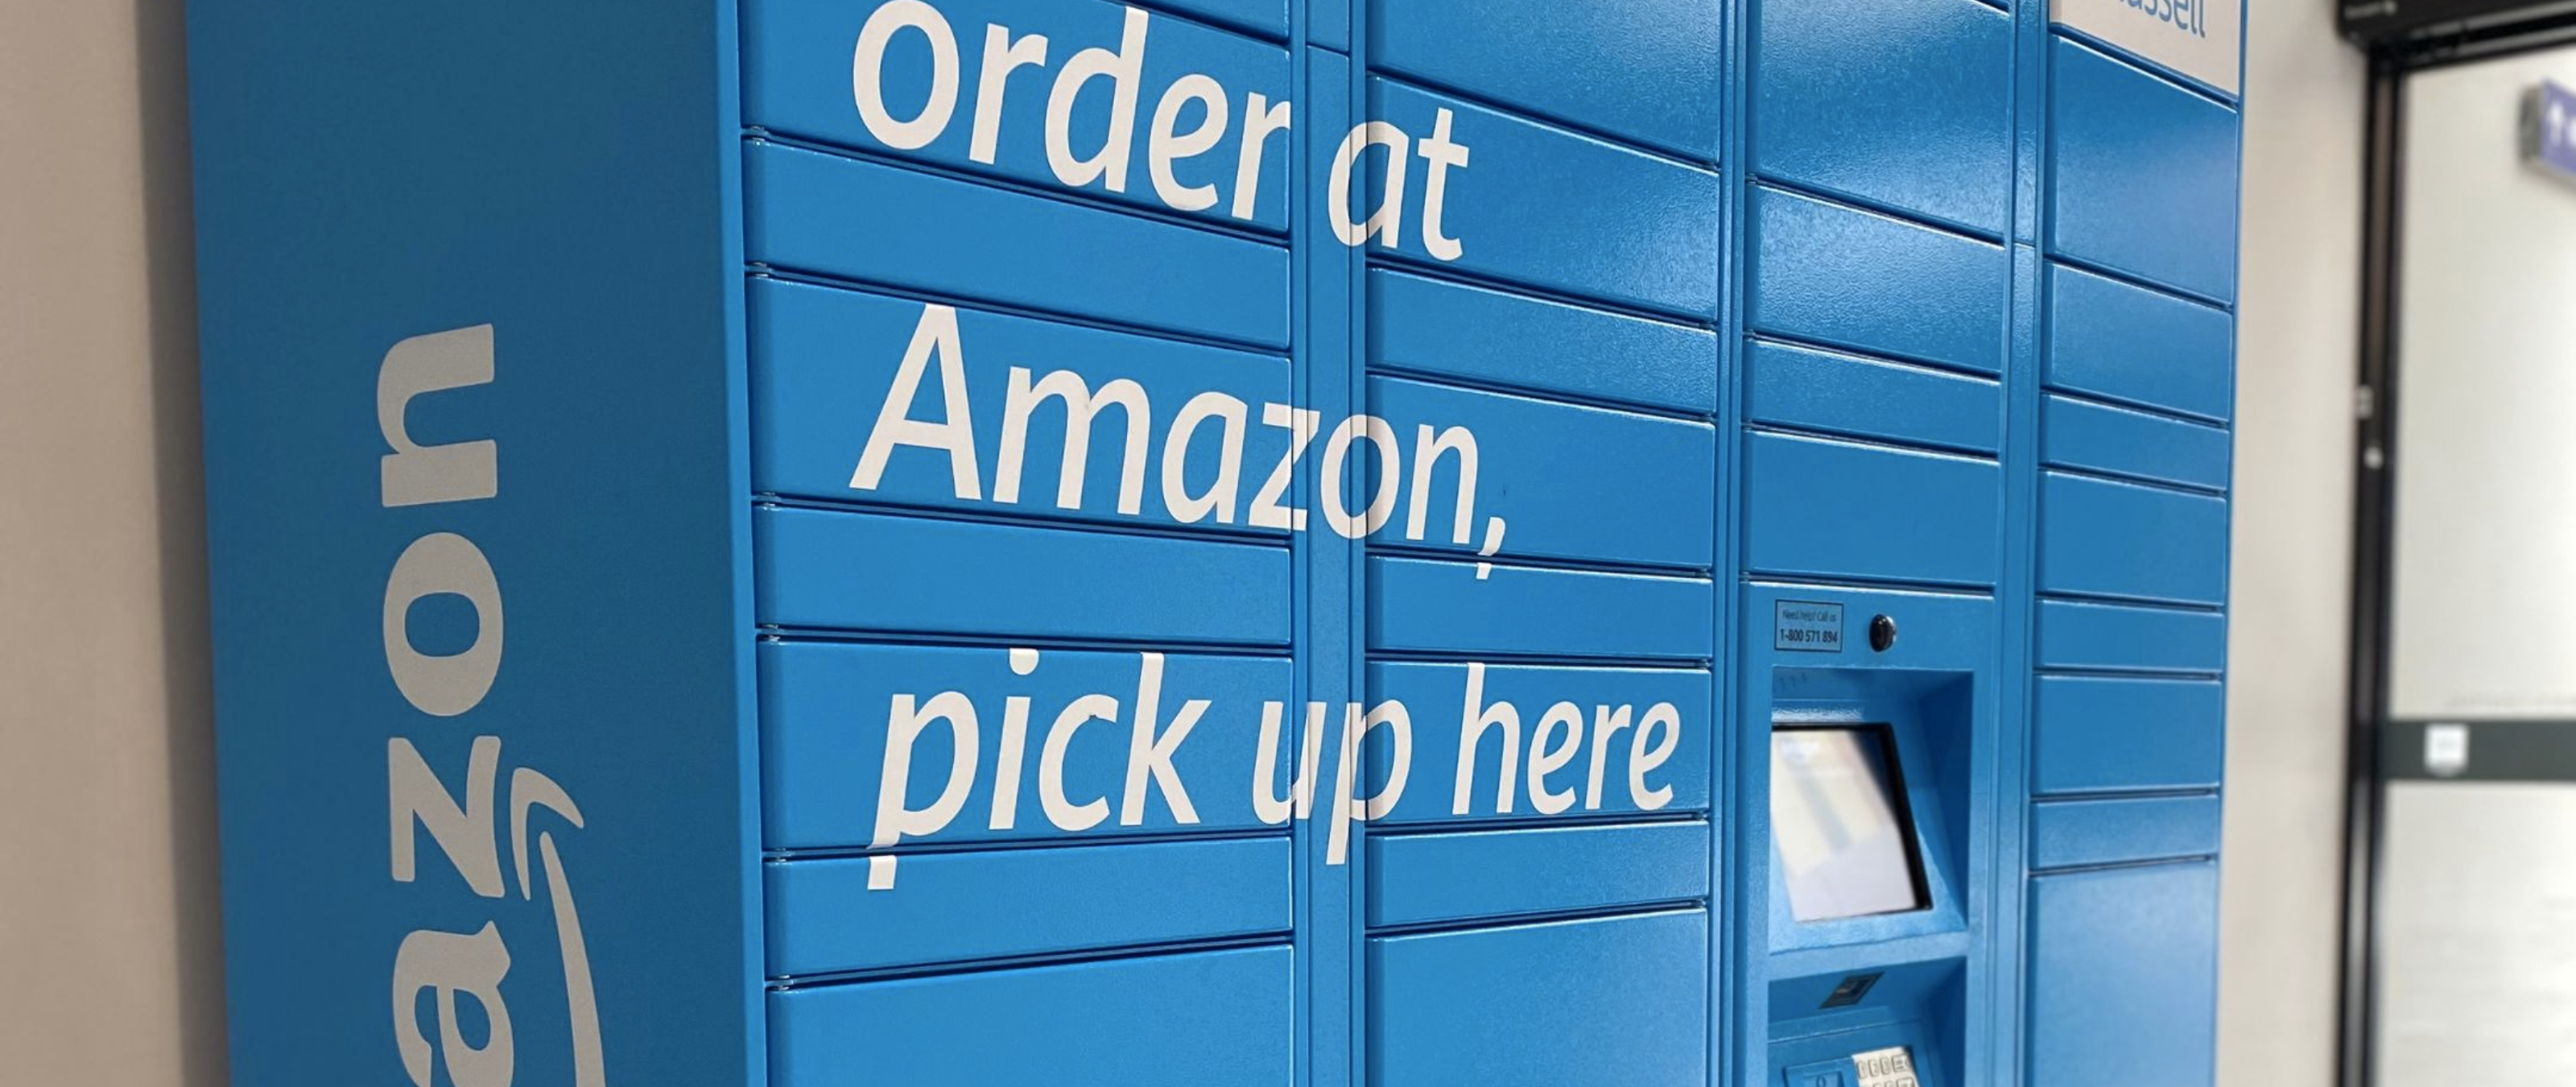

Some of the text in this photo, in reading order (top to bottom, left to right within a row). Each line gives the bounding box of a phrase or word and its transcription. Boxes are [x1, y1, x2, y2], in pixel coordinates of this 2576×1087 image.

[853, 0, 1469, 261] order at
[848, 303, 1506, 580] Amazon,
[1780, 628, 1838, 643] 1-800 571 894
[867, 647, 1680, 891] pick up here
